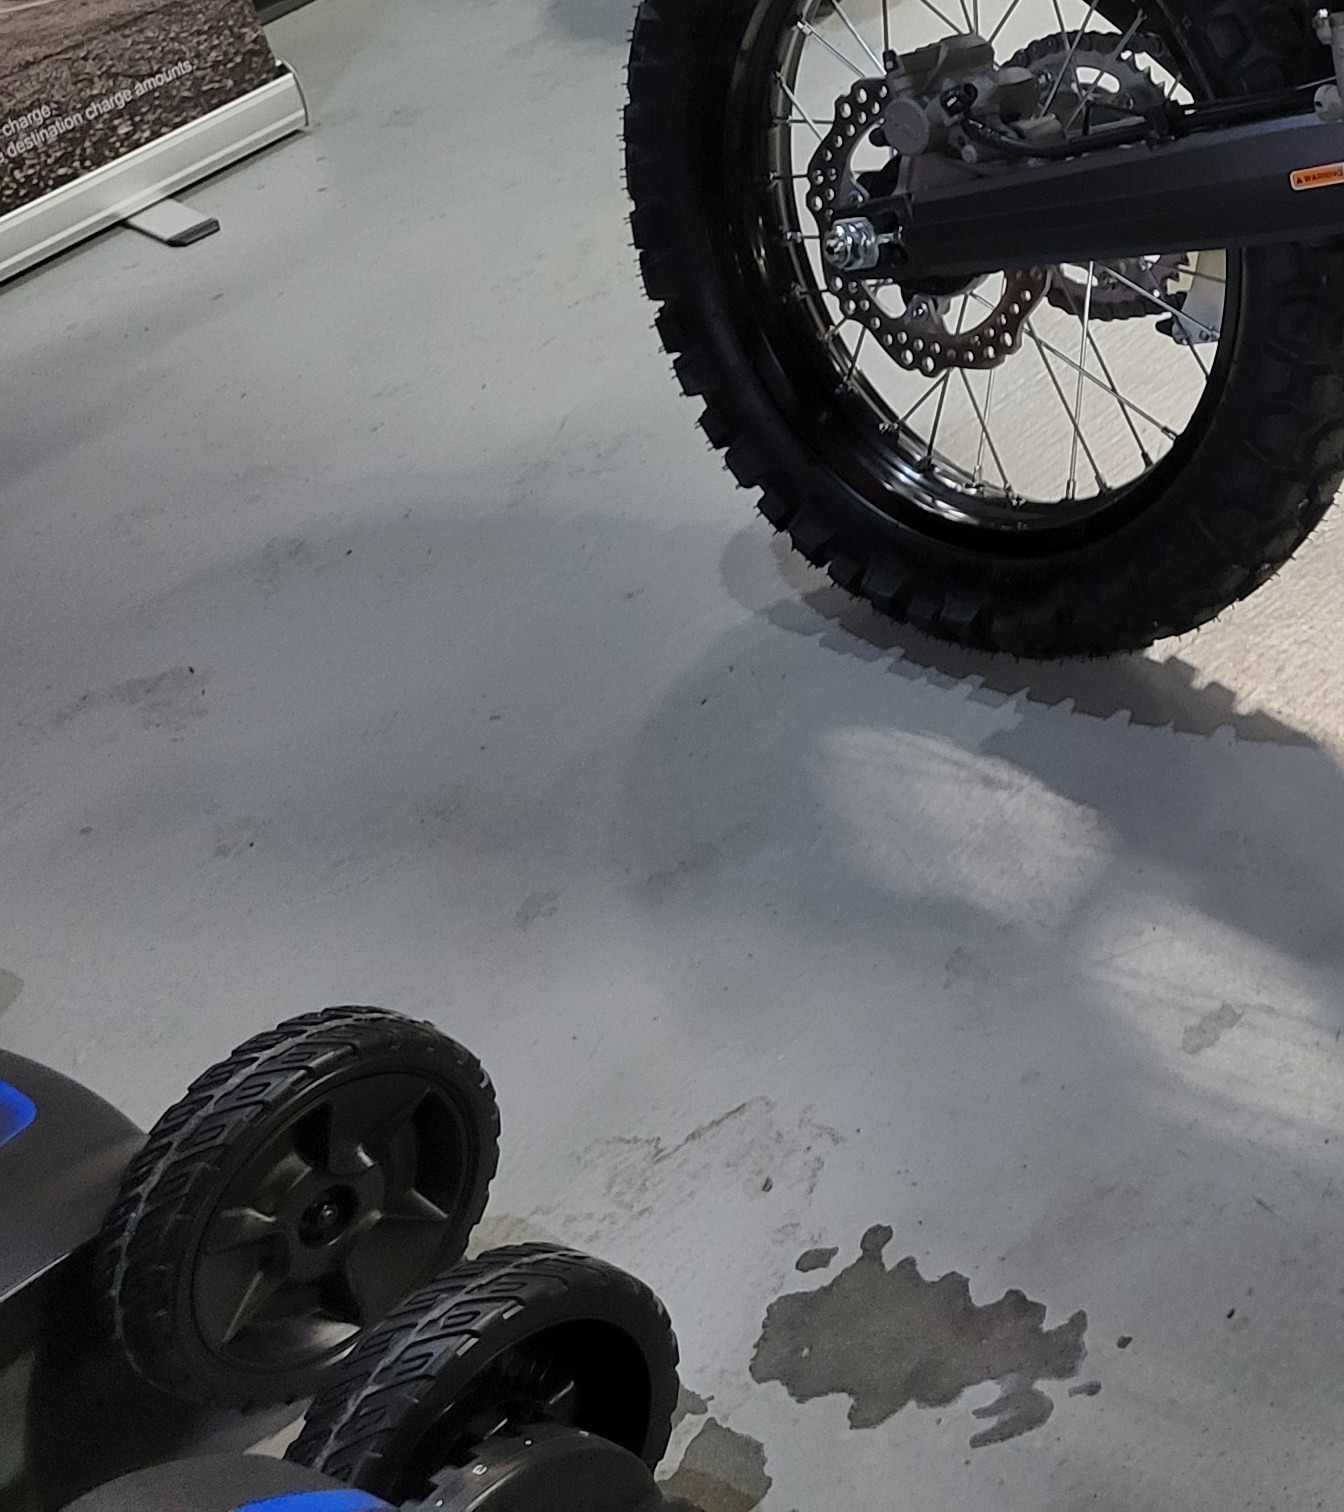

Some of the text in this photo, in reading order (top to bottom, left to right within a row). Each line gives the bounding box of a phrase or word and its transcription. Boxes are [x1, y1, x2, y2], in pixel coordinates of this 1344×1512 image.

[7, 59, 197, 159] destination charge amounts.
[1303, 168, 1344, 183] WARNING
